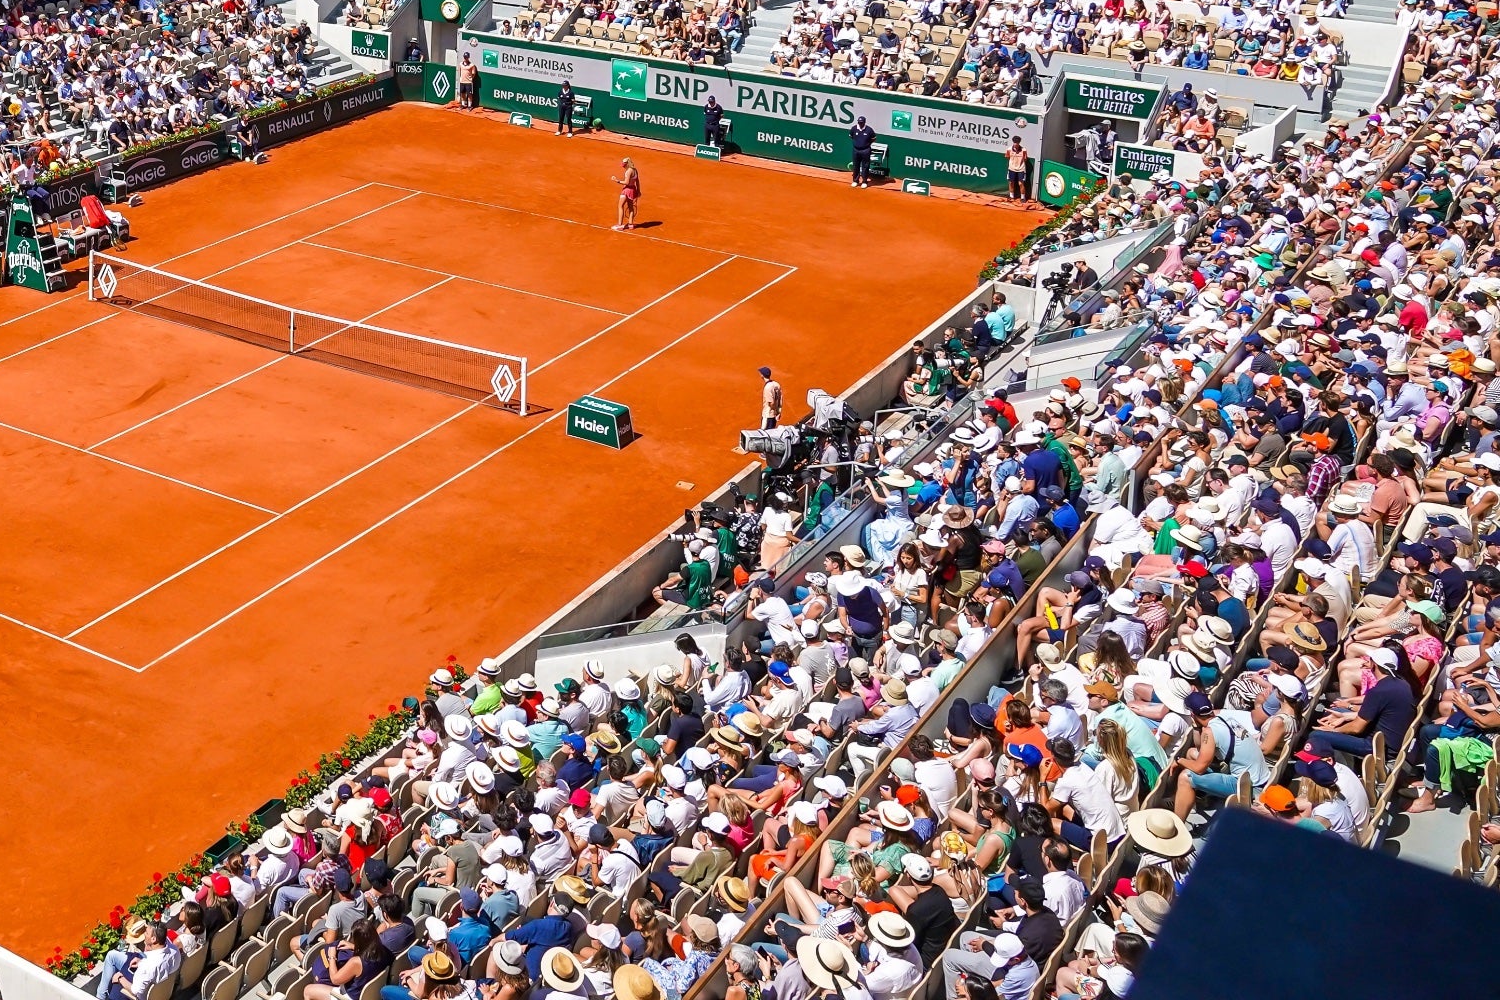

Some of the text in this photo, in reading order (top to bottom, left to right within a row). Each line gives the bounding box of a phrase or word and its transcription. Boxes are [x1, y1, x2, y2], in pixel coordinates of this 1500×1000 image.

[352, 45, 386, 59] ROLEX
[502, 52, 574, 73] BNP PARIBAS
[395, 63, 423, 75] Infosys
[342, 87, 384, 111] RENAULT
[493, 89, 558, 108] BNP PARIBAS
[655, 73, 855, 125] BNP PARIBAS
[1079, 83, 1145, 104] Emirates
[1087, 99, 1134, 115] FLY BETTER
[268, 110, 315, 135] RENAULT
[619, 109, 690, 130] BNP PARIBAS
[917, 115, 946, 129] BNP
[950, 119, 1010, 140] PARIBAS
[757, 131, 834, 153] BNP PARIBAS
[961, 135, 989, 145] changing
[904, 155, 988, 178] BNP PARIBAS
[1120, 148, 1172, 165] Emirates
[1126, 160, 1138, 170] FLY
[580, 398, 619, 412] Haier
[574, 415, 610, 436] Haier
[618, 422, 631, 435] Haier
